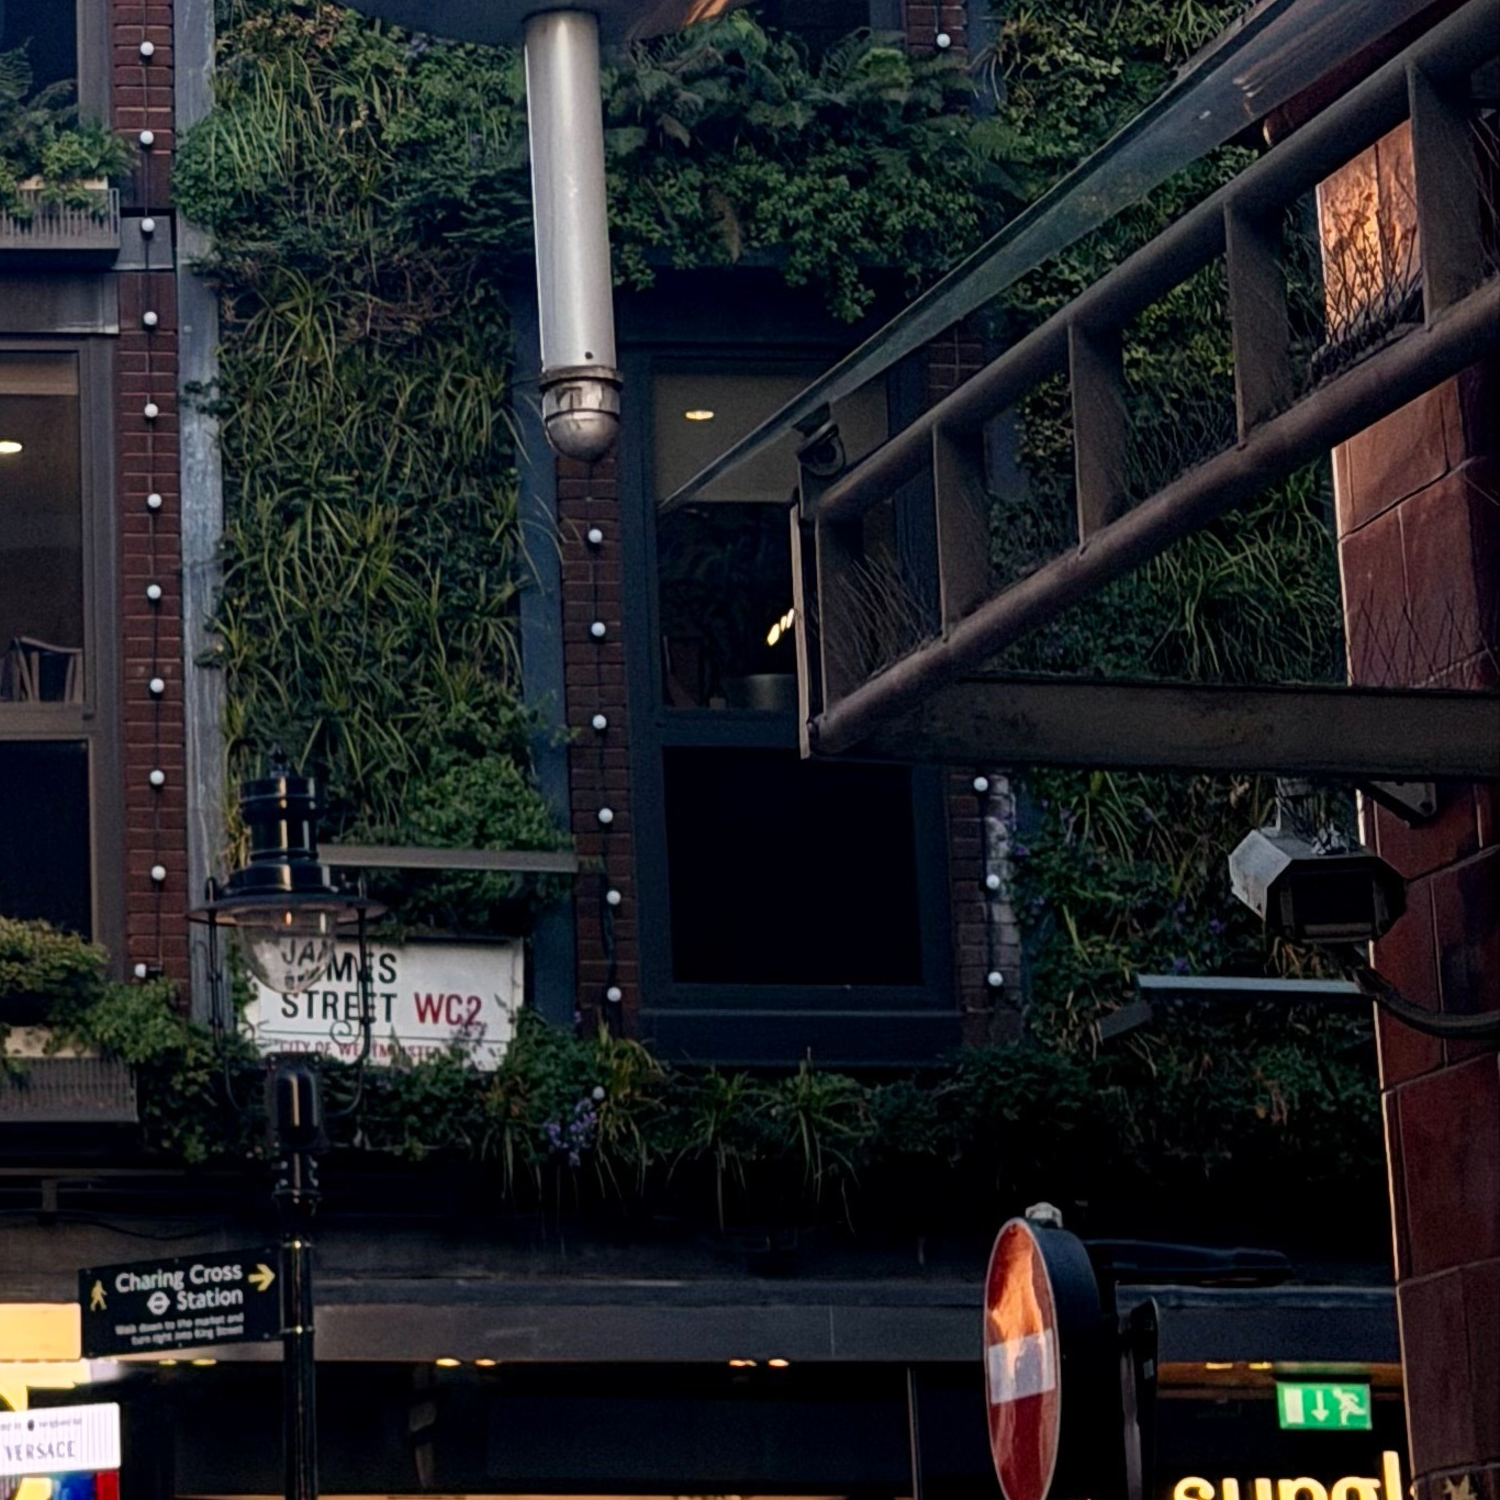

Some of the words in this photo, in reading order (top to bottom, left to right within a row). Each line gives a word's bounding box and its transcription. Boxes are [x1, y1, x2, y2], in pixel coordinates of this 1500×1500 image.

[413, 992, 482, 1026] WC2
[115, 1269, 185, 1293] Charing
[190, 1264, 244, 1284] Cross
[176, 1287, 244, 1311] Station
[3, 1440, 76, 1462] VERSACE
